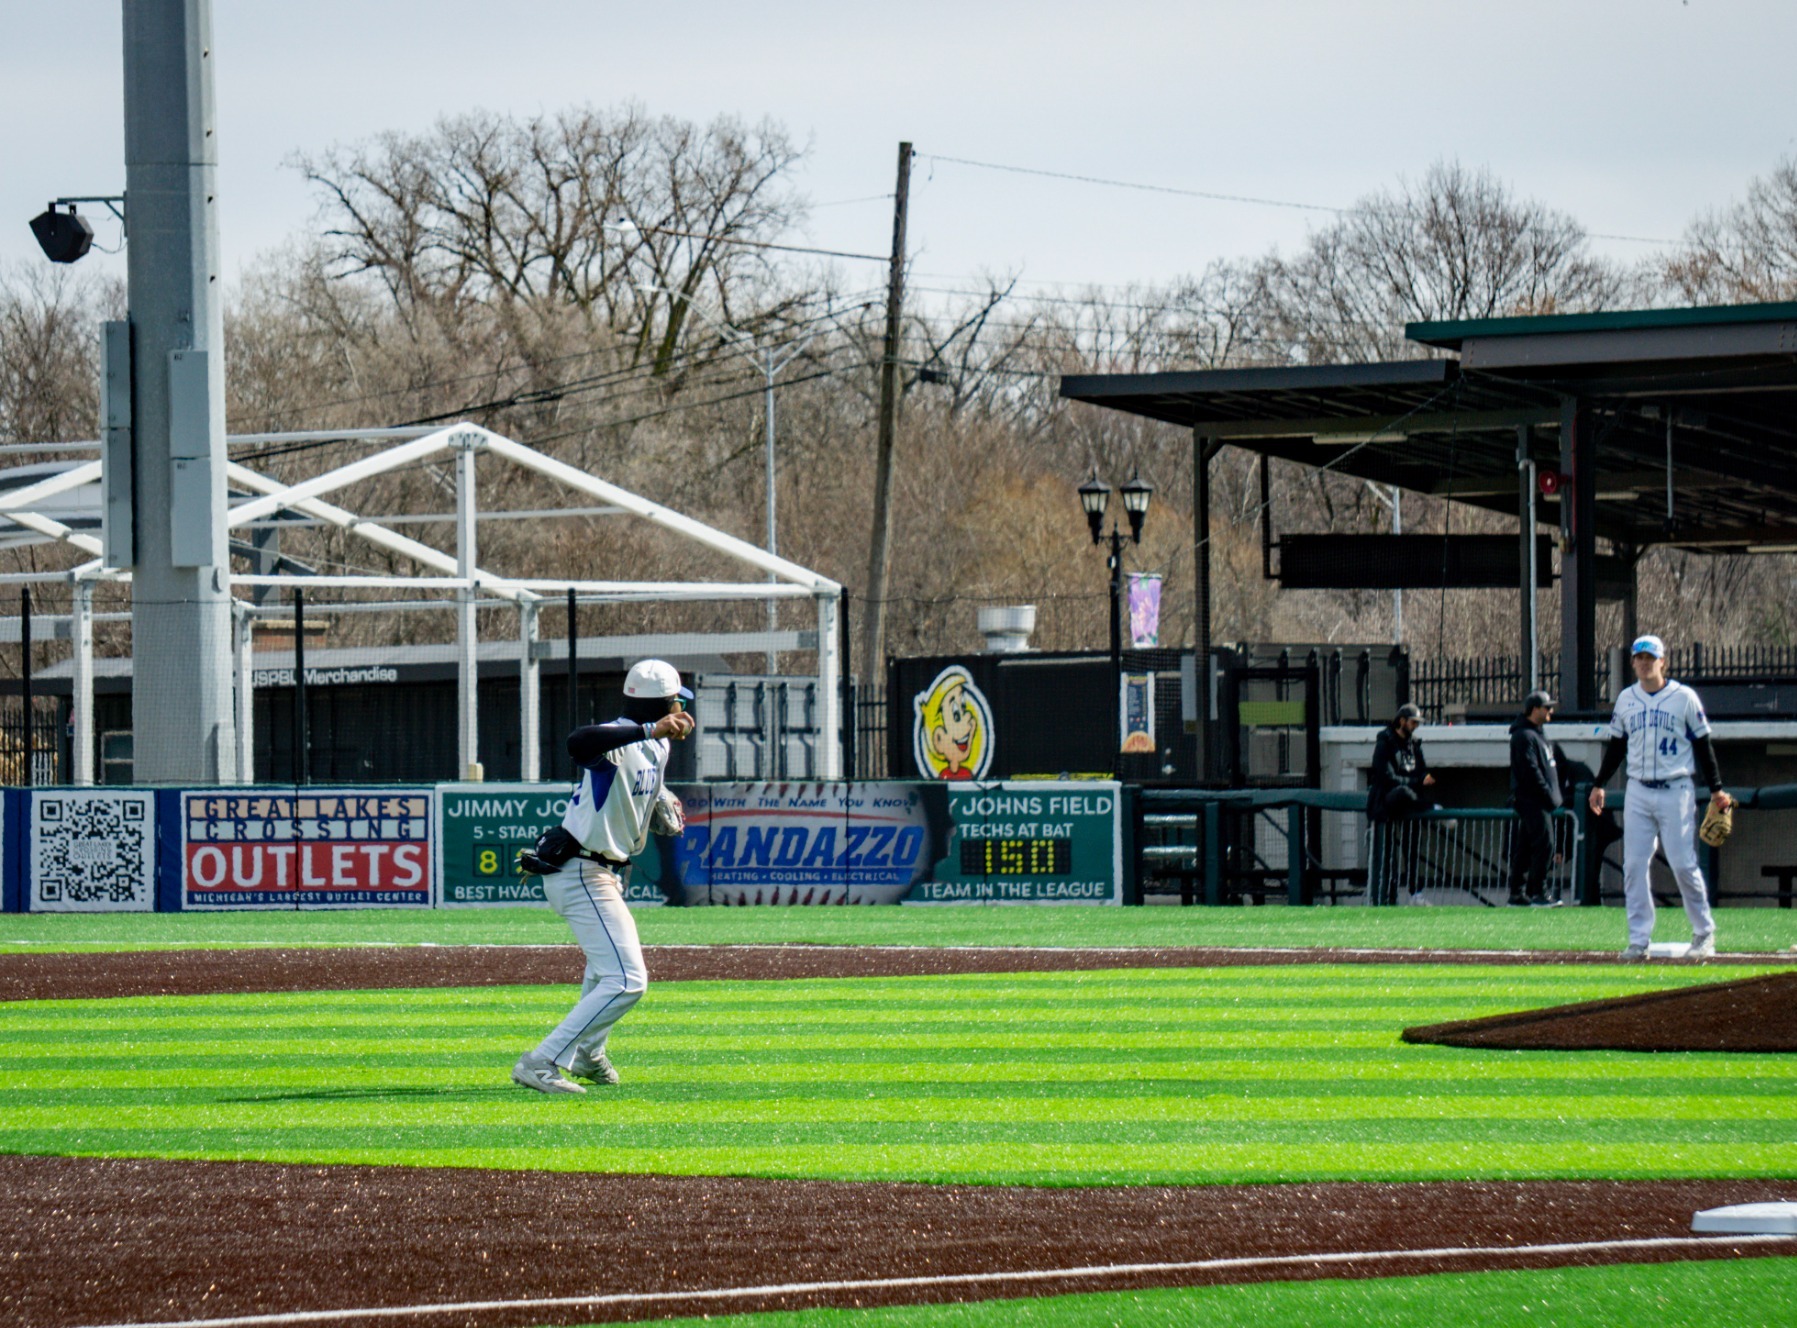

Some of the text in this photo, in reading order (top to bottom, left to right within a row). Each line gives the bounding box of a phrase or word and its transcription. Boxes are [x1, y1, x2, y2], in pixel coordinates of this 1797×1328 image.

[303, 666, 398, 685] Merchandise
[1630, 709, 1676, 734] BLUE DEVILS
[1659, 737, 1677, 756] 44
[205, 798, 411, 818] GREAT LAKES
[448, 799, 529, 818] JIMMY
[713, 797, 746, 808] WITH
[758, 798, 780, 808] THE
[788, 798, 827, 808] NAME
[838, 798, 864, 808] YOU
[962, 797, 1042, 816] JOHNS
[1050, 797, 1112, 816] FIELD
[206, 820, 411, 840] CROSSING
[473, 826, 484, 839] 5
[498, 826, 538, 839] STAR
[959, 823, 1074, 838] TECHS AT BAT
[479, 850, 499, 875] 8
[677, 825, 924, 885] RANDAZZO
[985, 840, 1054, 874] 150
[191, 844, 423, 888] OUTLETS
[770, 871, 821, 881] COOLING
[194, 891, 422, 903] MICHIGAN'S LARGEST OUTLET CENTER
[455, 886, 543, 899] BEST HVAC
[921, 882, 1105, 899] TEAM IN THE LEAGUE
